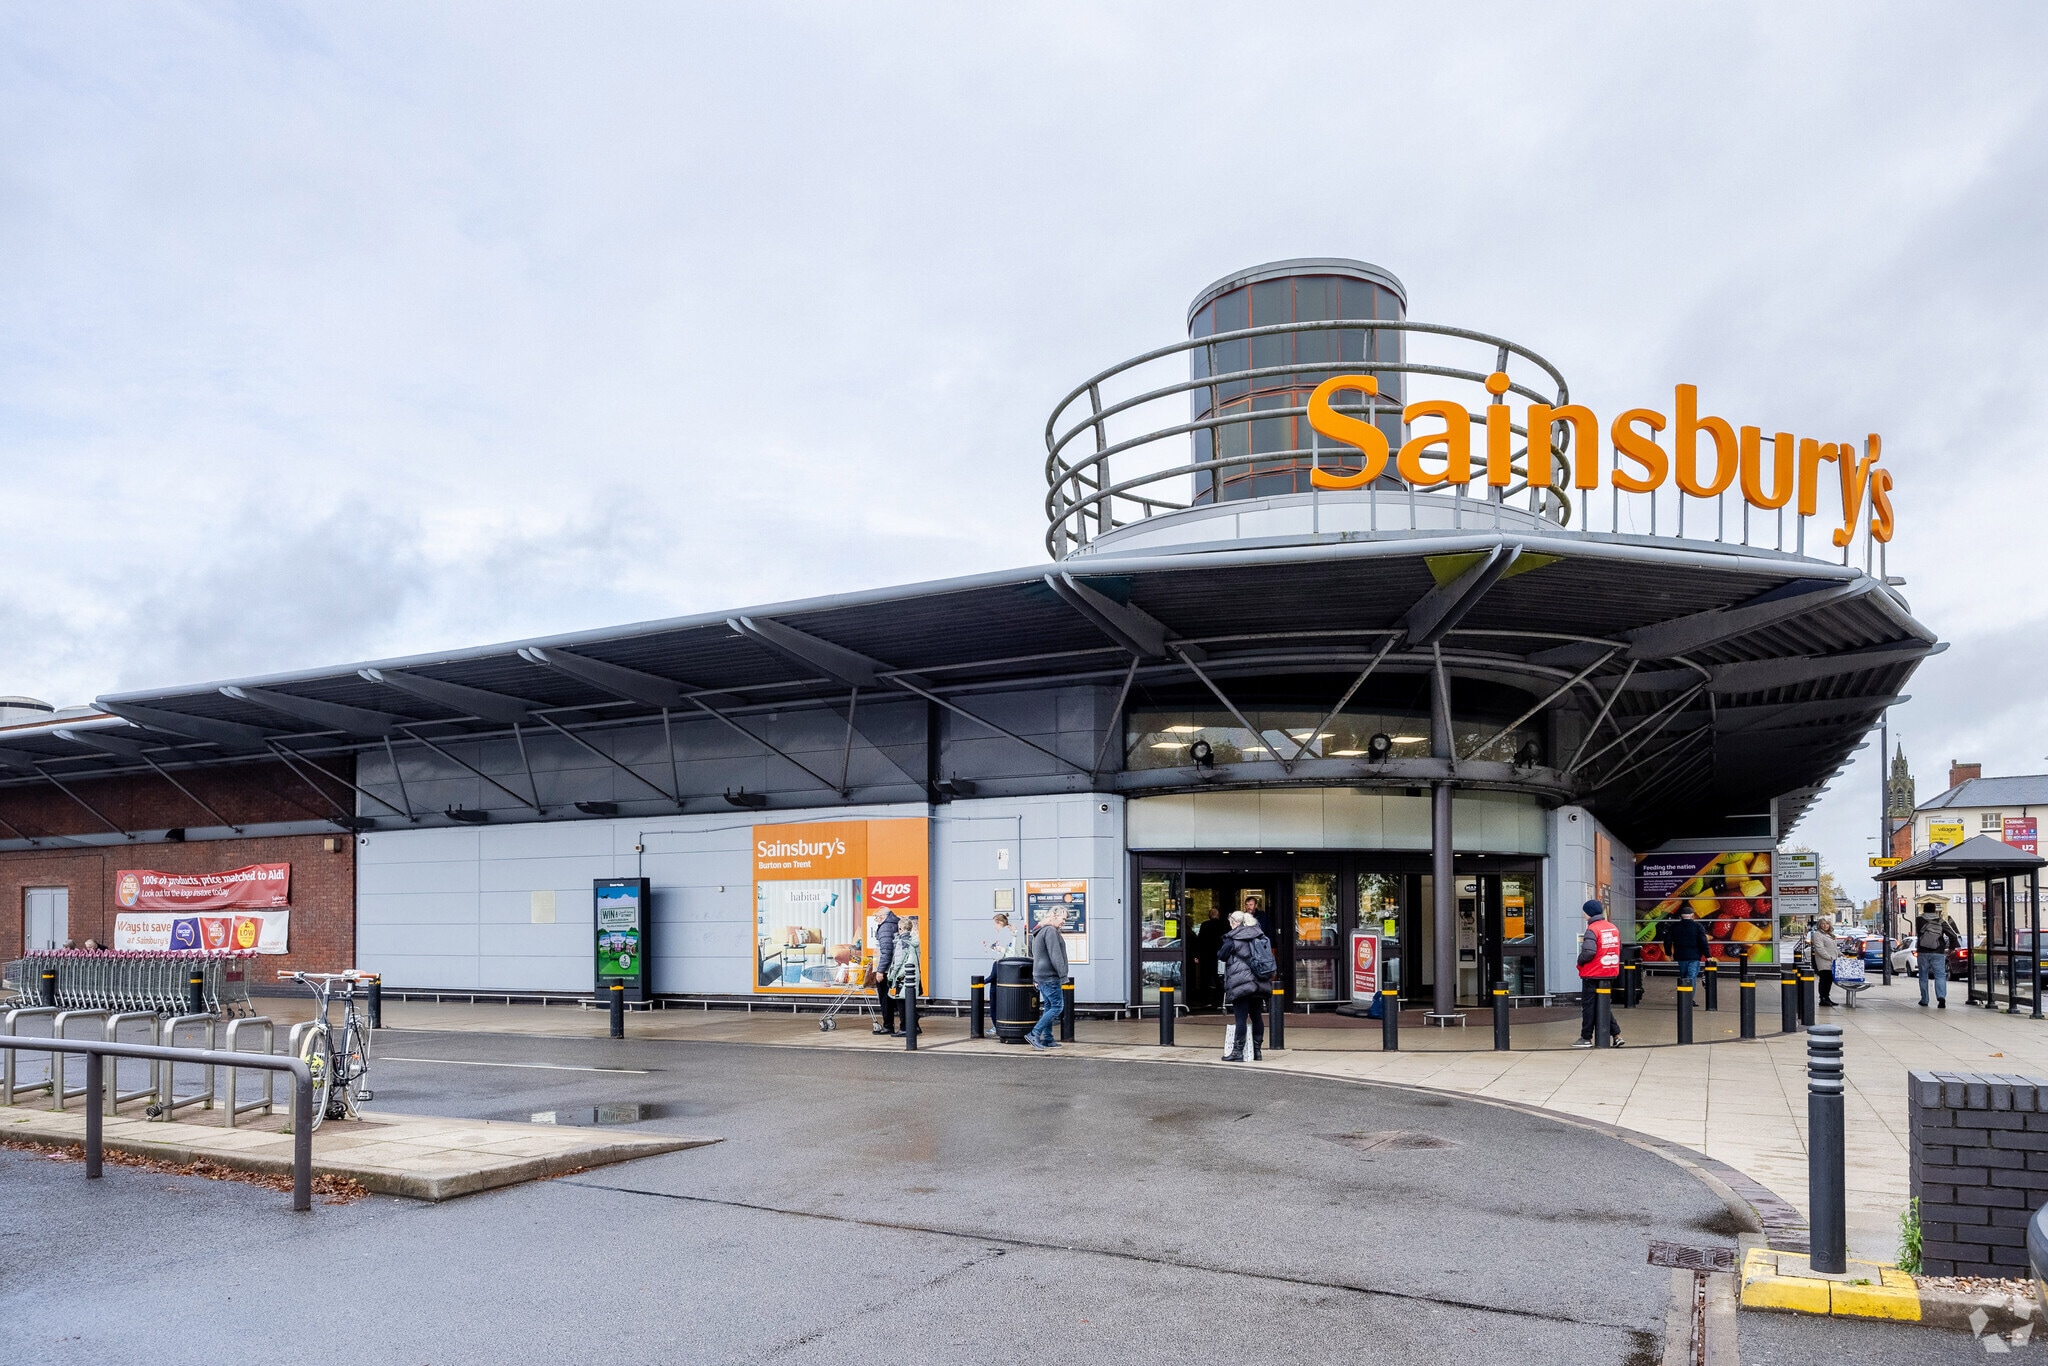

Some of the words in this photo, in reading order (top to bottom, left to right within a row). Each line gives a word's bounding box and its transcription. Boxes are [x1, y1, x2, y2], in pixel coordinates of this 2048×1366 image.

[1307, 371, 1894, 548] Sainsbury's
[757, 837, 846, 860] Sainsbury's
[758, 862, 782, 870] Burton
[793, 860, 811, 868] Trent
[142, 876, 158, 885] 100s
[202, 874, 222, 887] price
[222, 870, 256, 883] matched
[257, 872, 267, 880] to
[268, 869, 284, 880] Aldi
[142, 889, 154, 898] Look
[171, 889, 180, 897] the
[181, 888, 192, 899] logo
[212, 888, 229, 897] today
[871, 880, 911, 899] Argos
[790, 891, 820, 902] habitat
[602, 910, 614, 920] WIN
[118, 921, 140, 934] Ways
[151, 923, 171, 932] save
[136, 936, 169, 946] Sainsbury's
